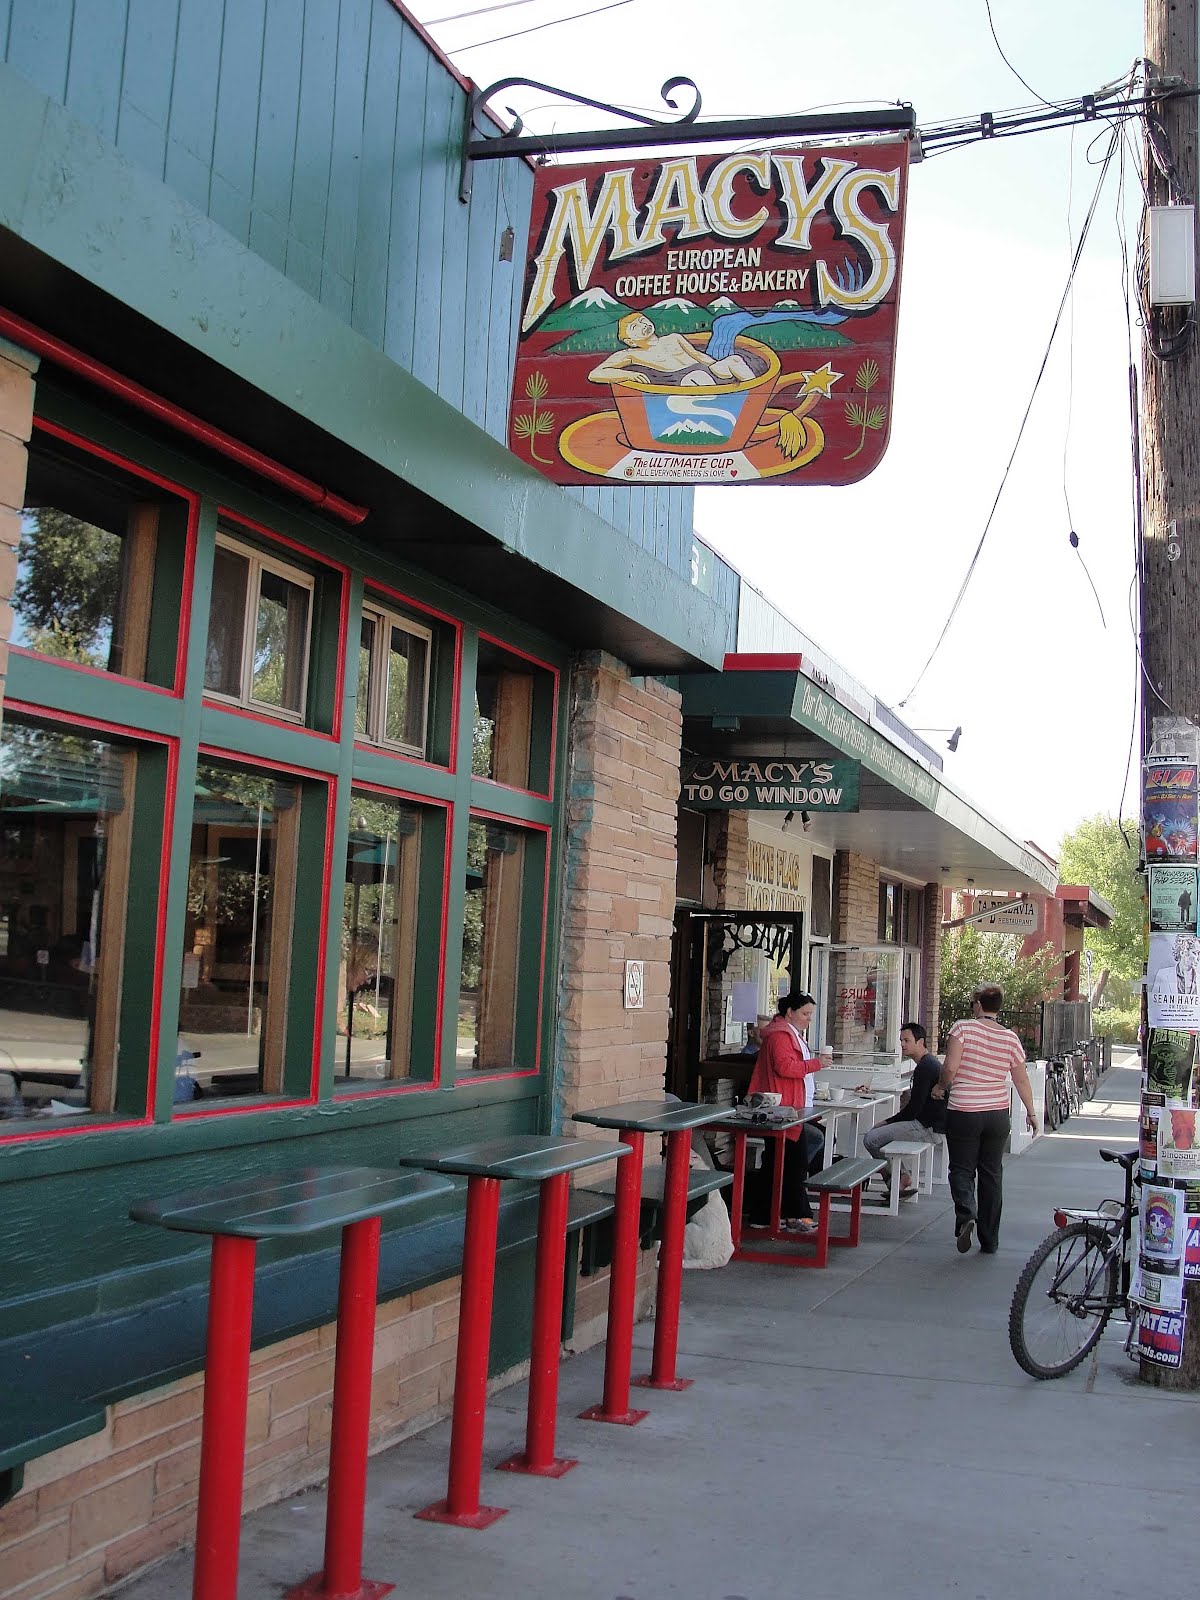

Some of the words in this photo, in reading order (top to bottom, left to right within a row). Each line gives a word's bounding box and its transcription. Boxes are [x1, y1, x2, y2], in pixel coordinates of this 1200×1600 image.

[667, 247, 762, 271] EUROPEAN
[615, 274, 671, 297] COFFEE
[633, 457, 648, 468] The
[649, 457, 708, 469] ULTIMATE
[710, 458, 734, 469] CUP
[636, 469, 649, 477] ALL
[650, 469, 681, 478] EVERYONE
[682, 469, 701, 478] NEEDS
[702, 469, 709, 477] IS
[710, 469, 725, 477] LOVE
[692, 760, 836, 784] MACY'S
[684, 784, 714, 801] TO
[719, 785, 749, 802] GO
[755, 786, 842, 805] WINDOW
[1153, 994, 1175, 1004] SEAN
